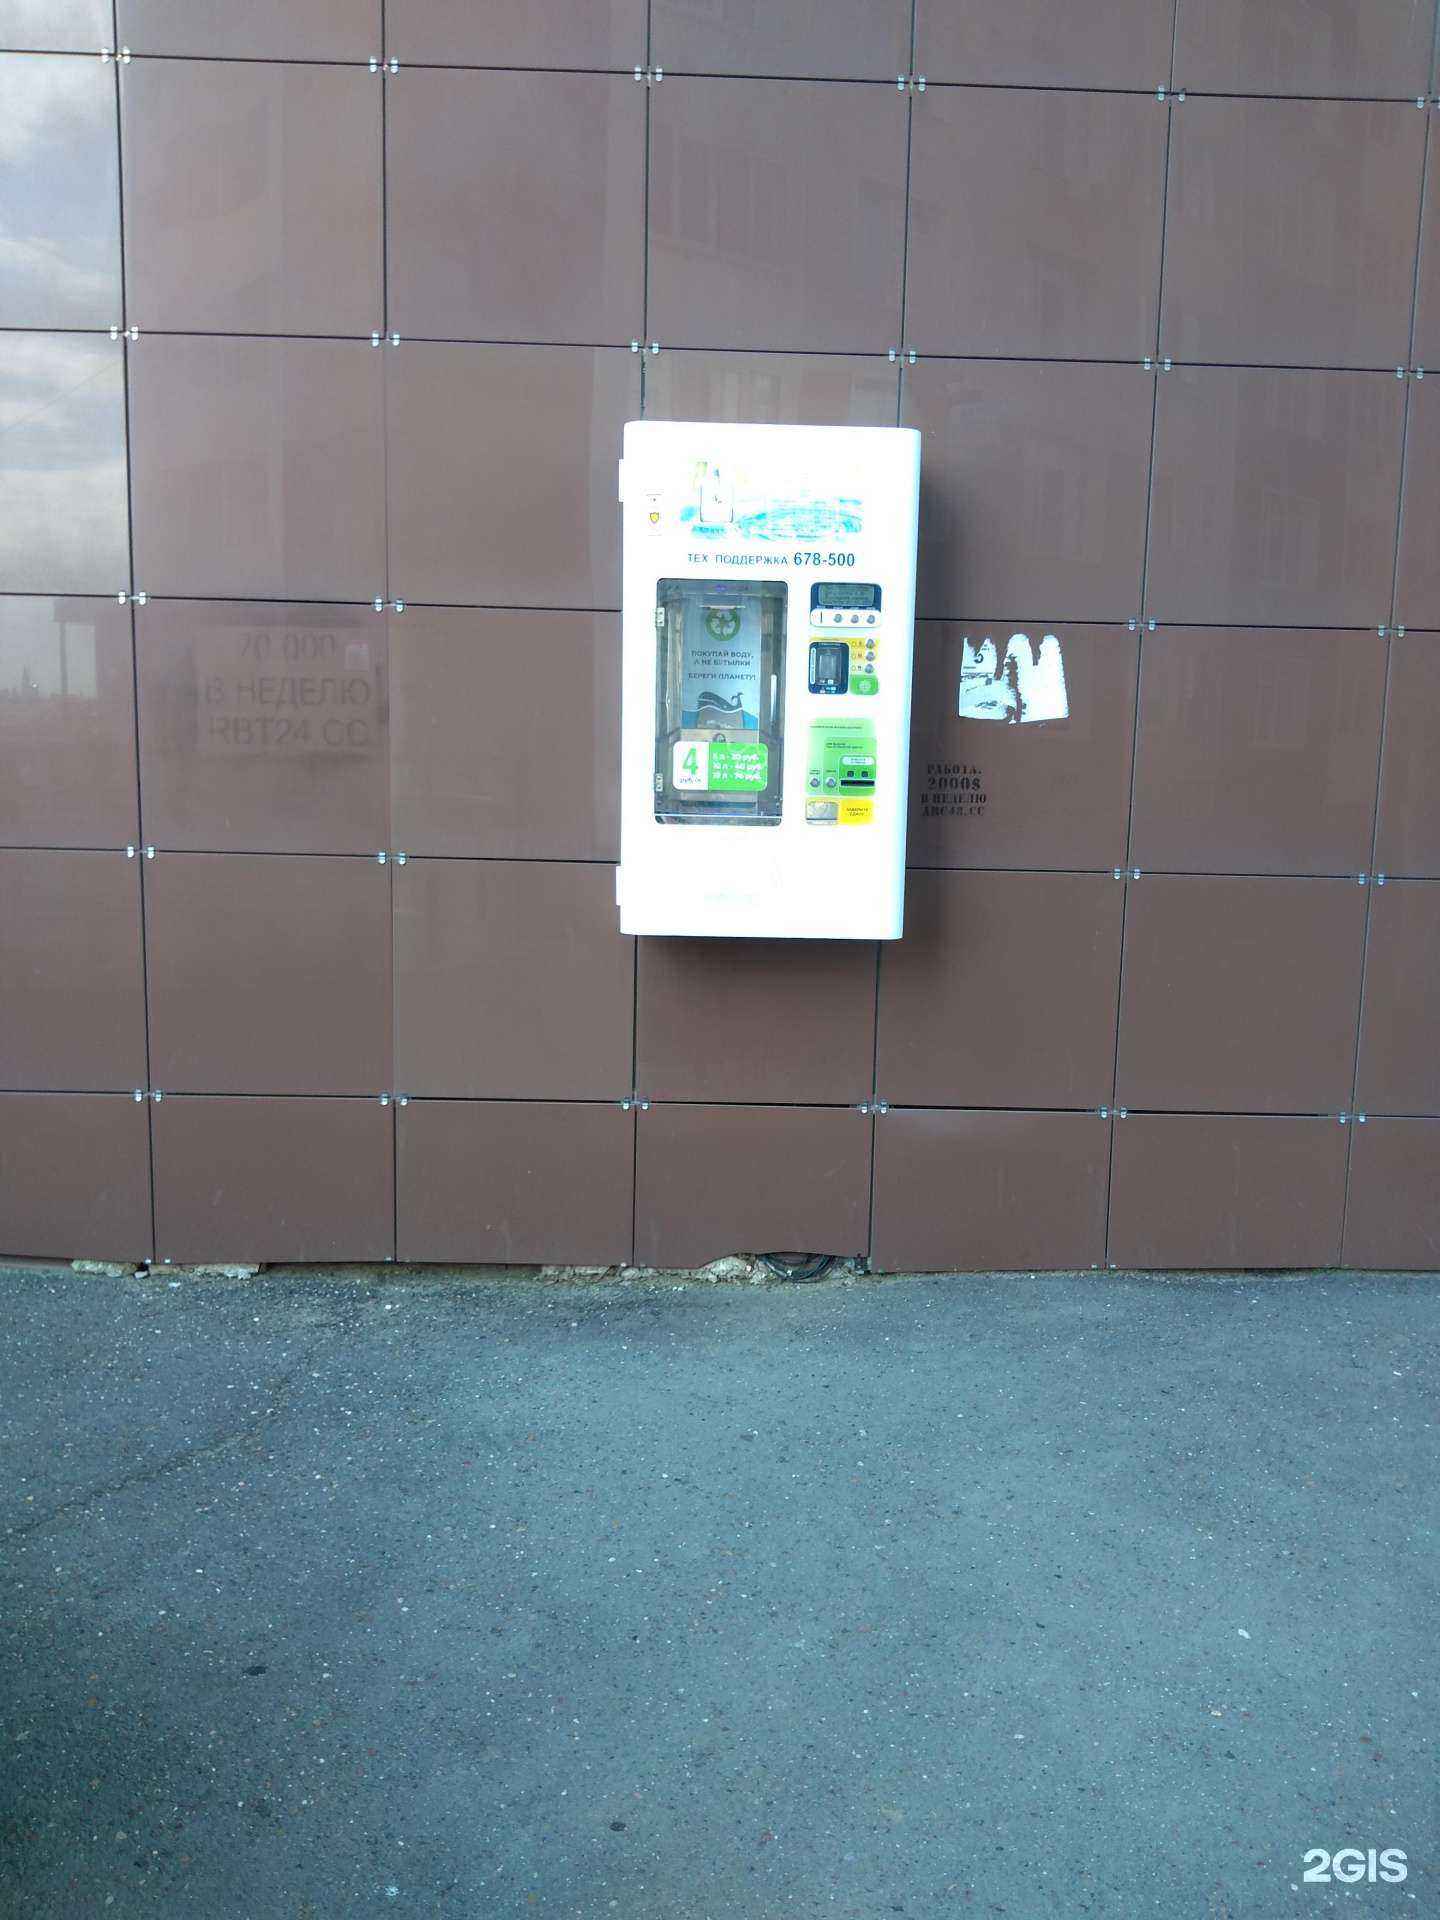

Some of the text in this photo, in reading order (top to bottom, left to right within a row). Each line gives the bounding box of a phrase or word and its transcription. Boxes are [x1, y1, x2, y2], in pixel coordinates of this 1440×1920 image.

[688, 551, 855, 567] ТЕХ ПОДДЕРЖКА 678-500
[691, 649, 729, 658] ПОКУПАЙ
[713, 659, 751, 667] БУТЫЛКИ
[238, 676, 372, 709] НЕДЕЛЮ
[682, 747, 699, 776] 4
